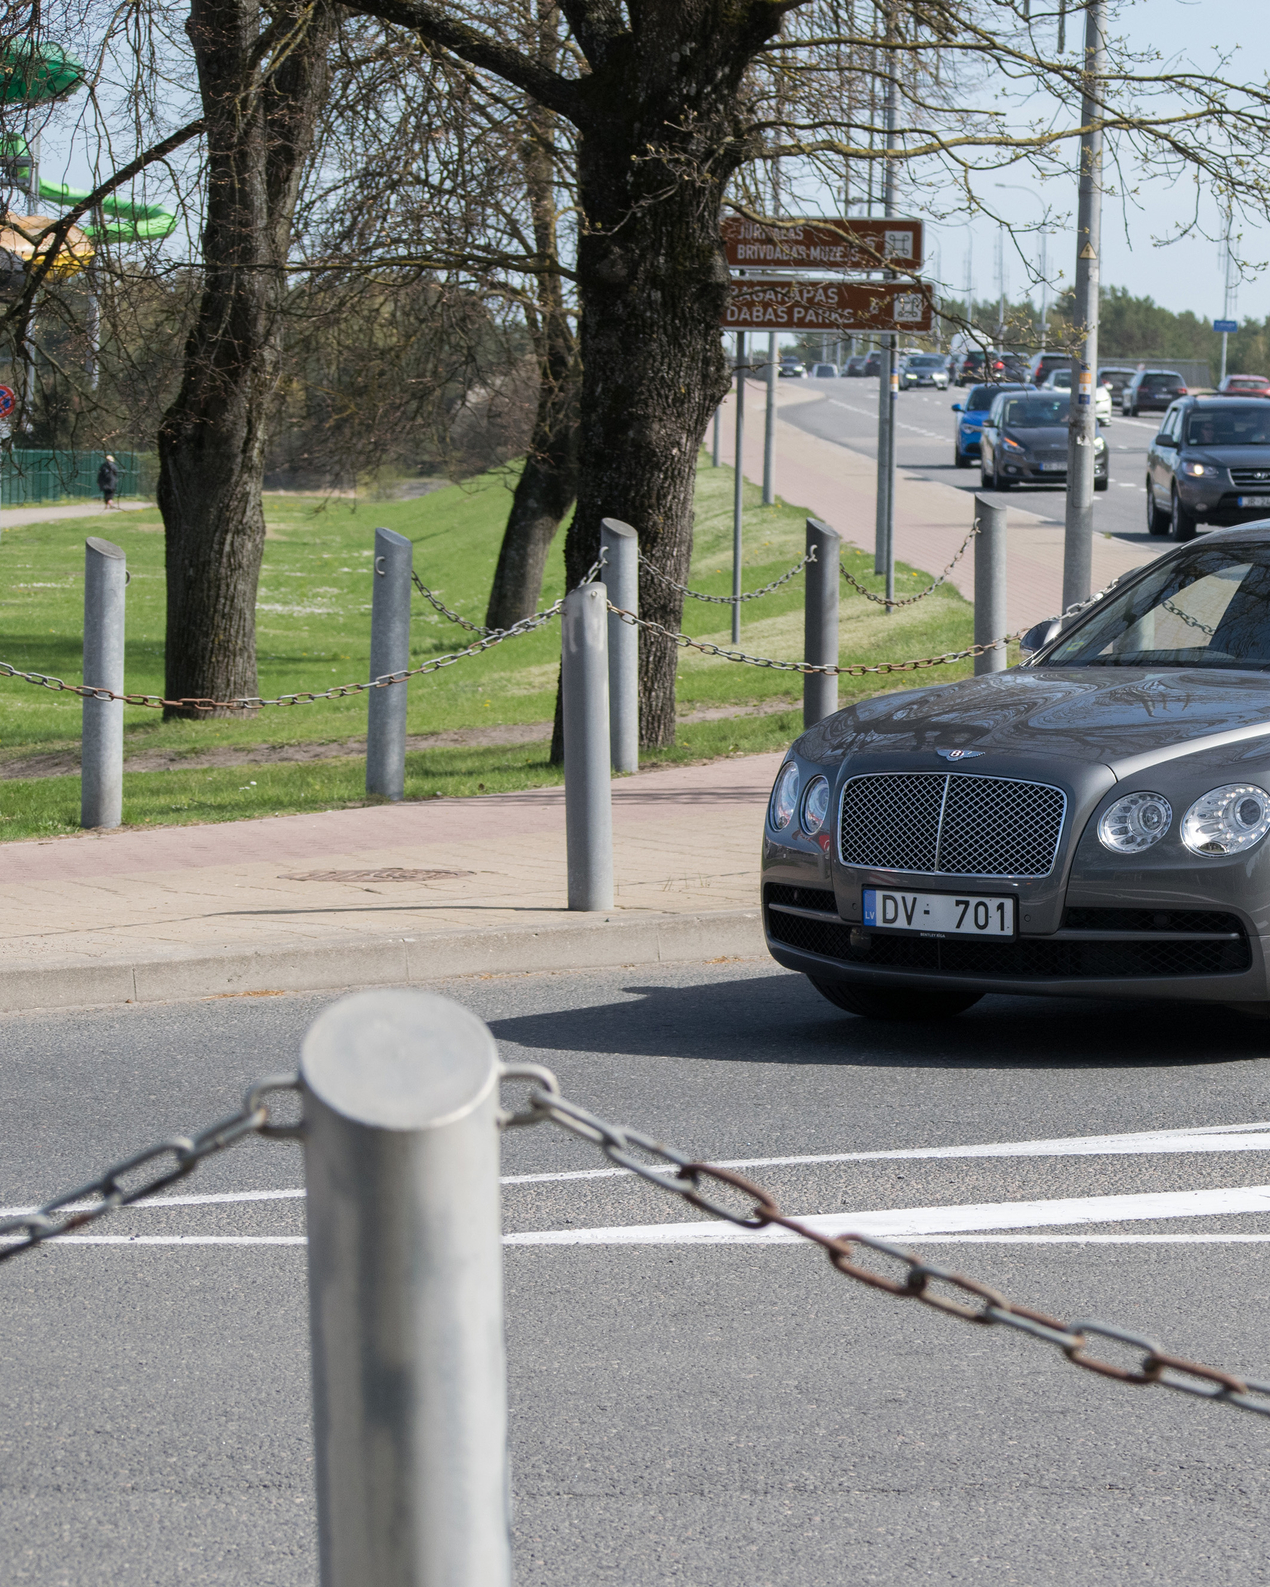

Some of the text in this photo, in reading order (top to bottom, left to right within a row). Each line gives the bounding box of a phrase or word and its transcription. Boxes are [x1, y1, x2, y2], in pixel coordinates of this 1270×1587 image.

[727, 307, 855, 323] DABAS PARKS
[865, 911, 875, 920] LV
[954, 899, 1005, 931] 701
